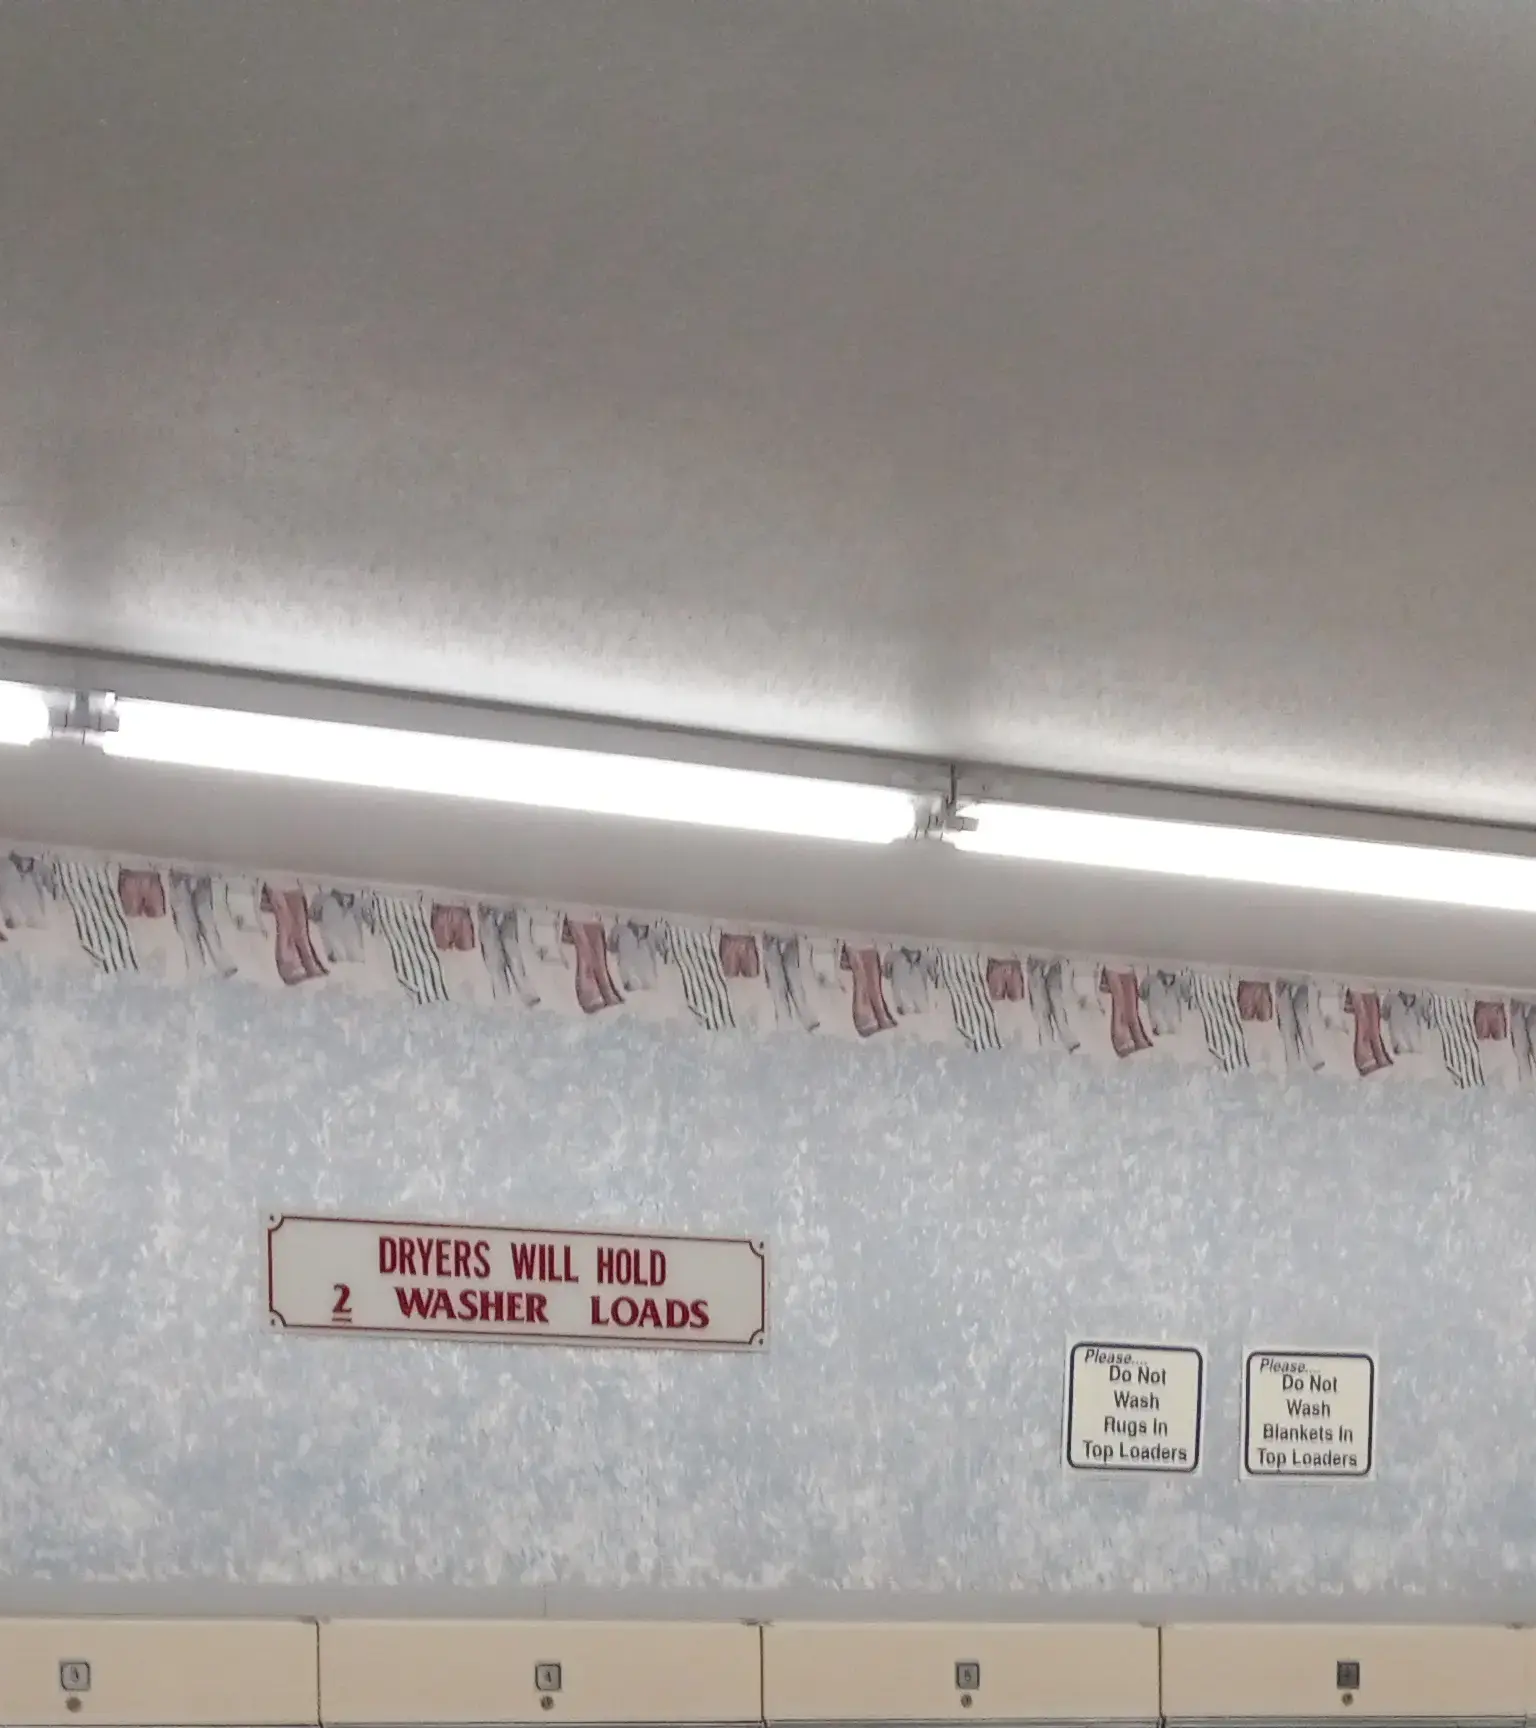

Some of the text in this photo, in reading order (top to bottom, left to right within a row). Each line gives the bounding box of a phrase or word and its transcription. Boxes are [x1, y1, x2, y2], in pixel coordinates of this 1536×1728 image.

[378, 1235, 667, 1286] DRYERS WILL HOLD
[332, 1283, 711, 1330] 2 WASHER LOADS
[1108, 1364, 1167, 1386] Do Not
[1281, 1373, 1338, 1393] Do Not
[1113, 1389, 1161, 1412] Wash
[1285, 1398, 1332, 1419] Wash
[1103, 1415, 1169, 1438] Rugs In
[1262, 1423, 1354, 1444] Blankets In
[1082, 1439, 1188, 1463] Top Loaders
[1257, 1447, 1358, 1468] Top Loaders
